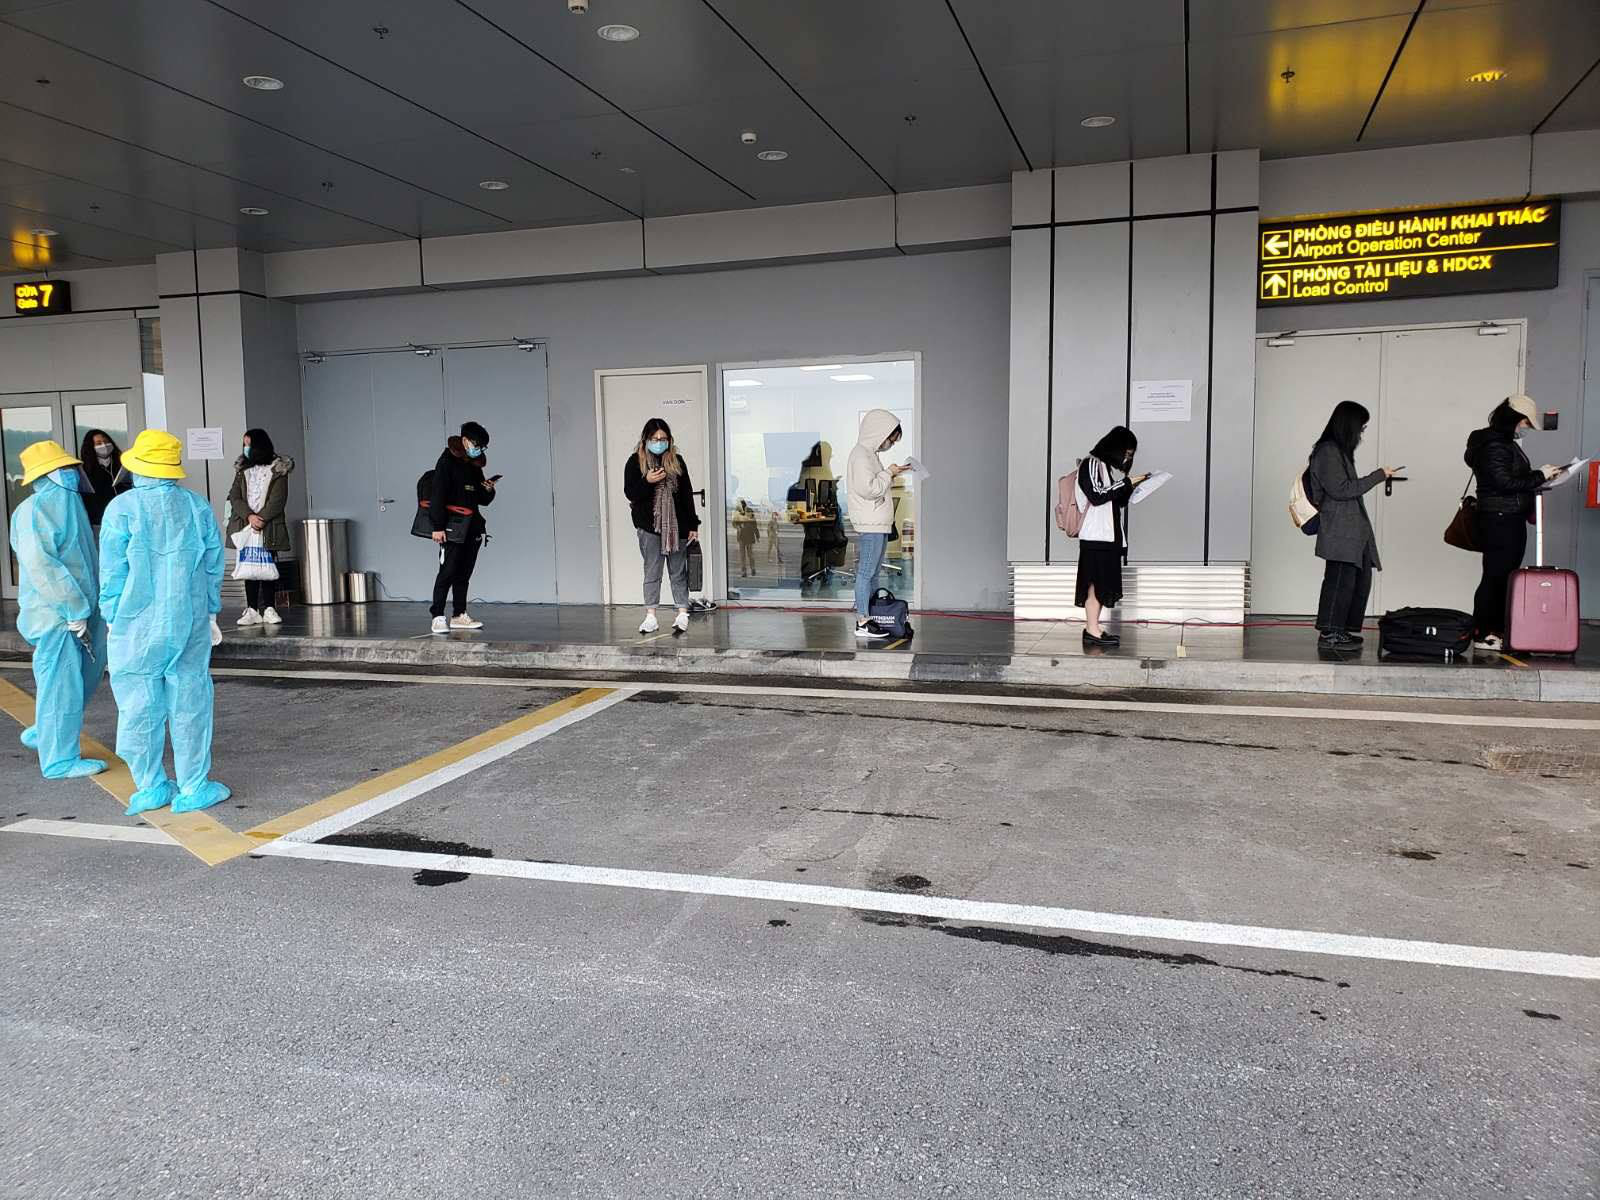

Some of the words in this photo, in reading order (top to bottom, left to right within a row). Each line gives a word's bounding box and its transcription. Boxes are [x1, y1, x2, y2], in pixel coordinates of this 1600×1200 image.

[1293, 224, 1352, 243] PHÒNG
[1398, 216, 1447, 234] HÀNH
[1451, 212, 1494, 230] KHAI
[1497, 206, 1548, 226] THÁC
[1293, 241, 1344, 259] Airport
[1347, 236, 1422, 256] Operation
[1426, 231, 1482, 248] Center
[1292, 265, 1351, 283] PHÒNG
[1354, 261, 1381, 279] TÀI
[1384, 260, 1422, 279] LIỆU
[1426, 258, 1439, 274] &
[1442, 255, 1493, 273] HDCX
[39, 284, 53, 308] 7
[1293, 282, 1330, 298] Load
[1333, 278, 1389, 295] Control
